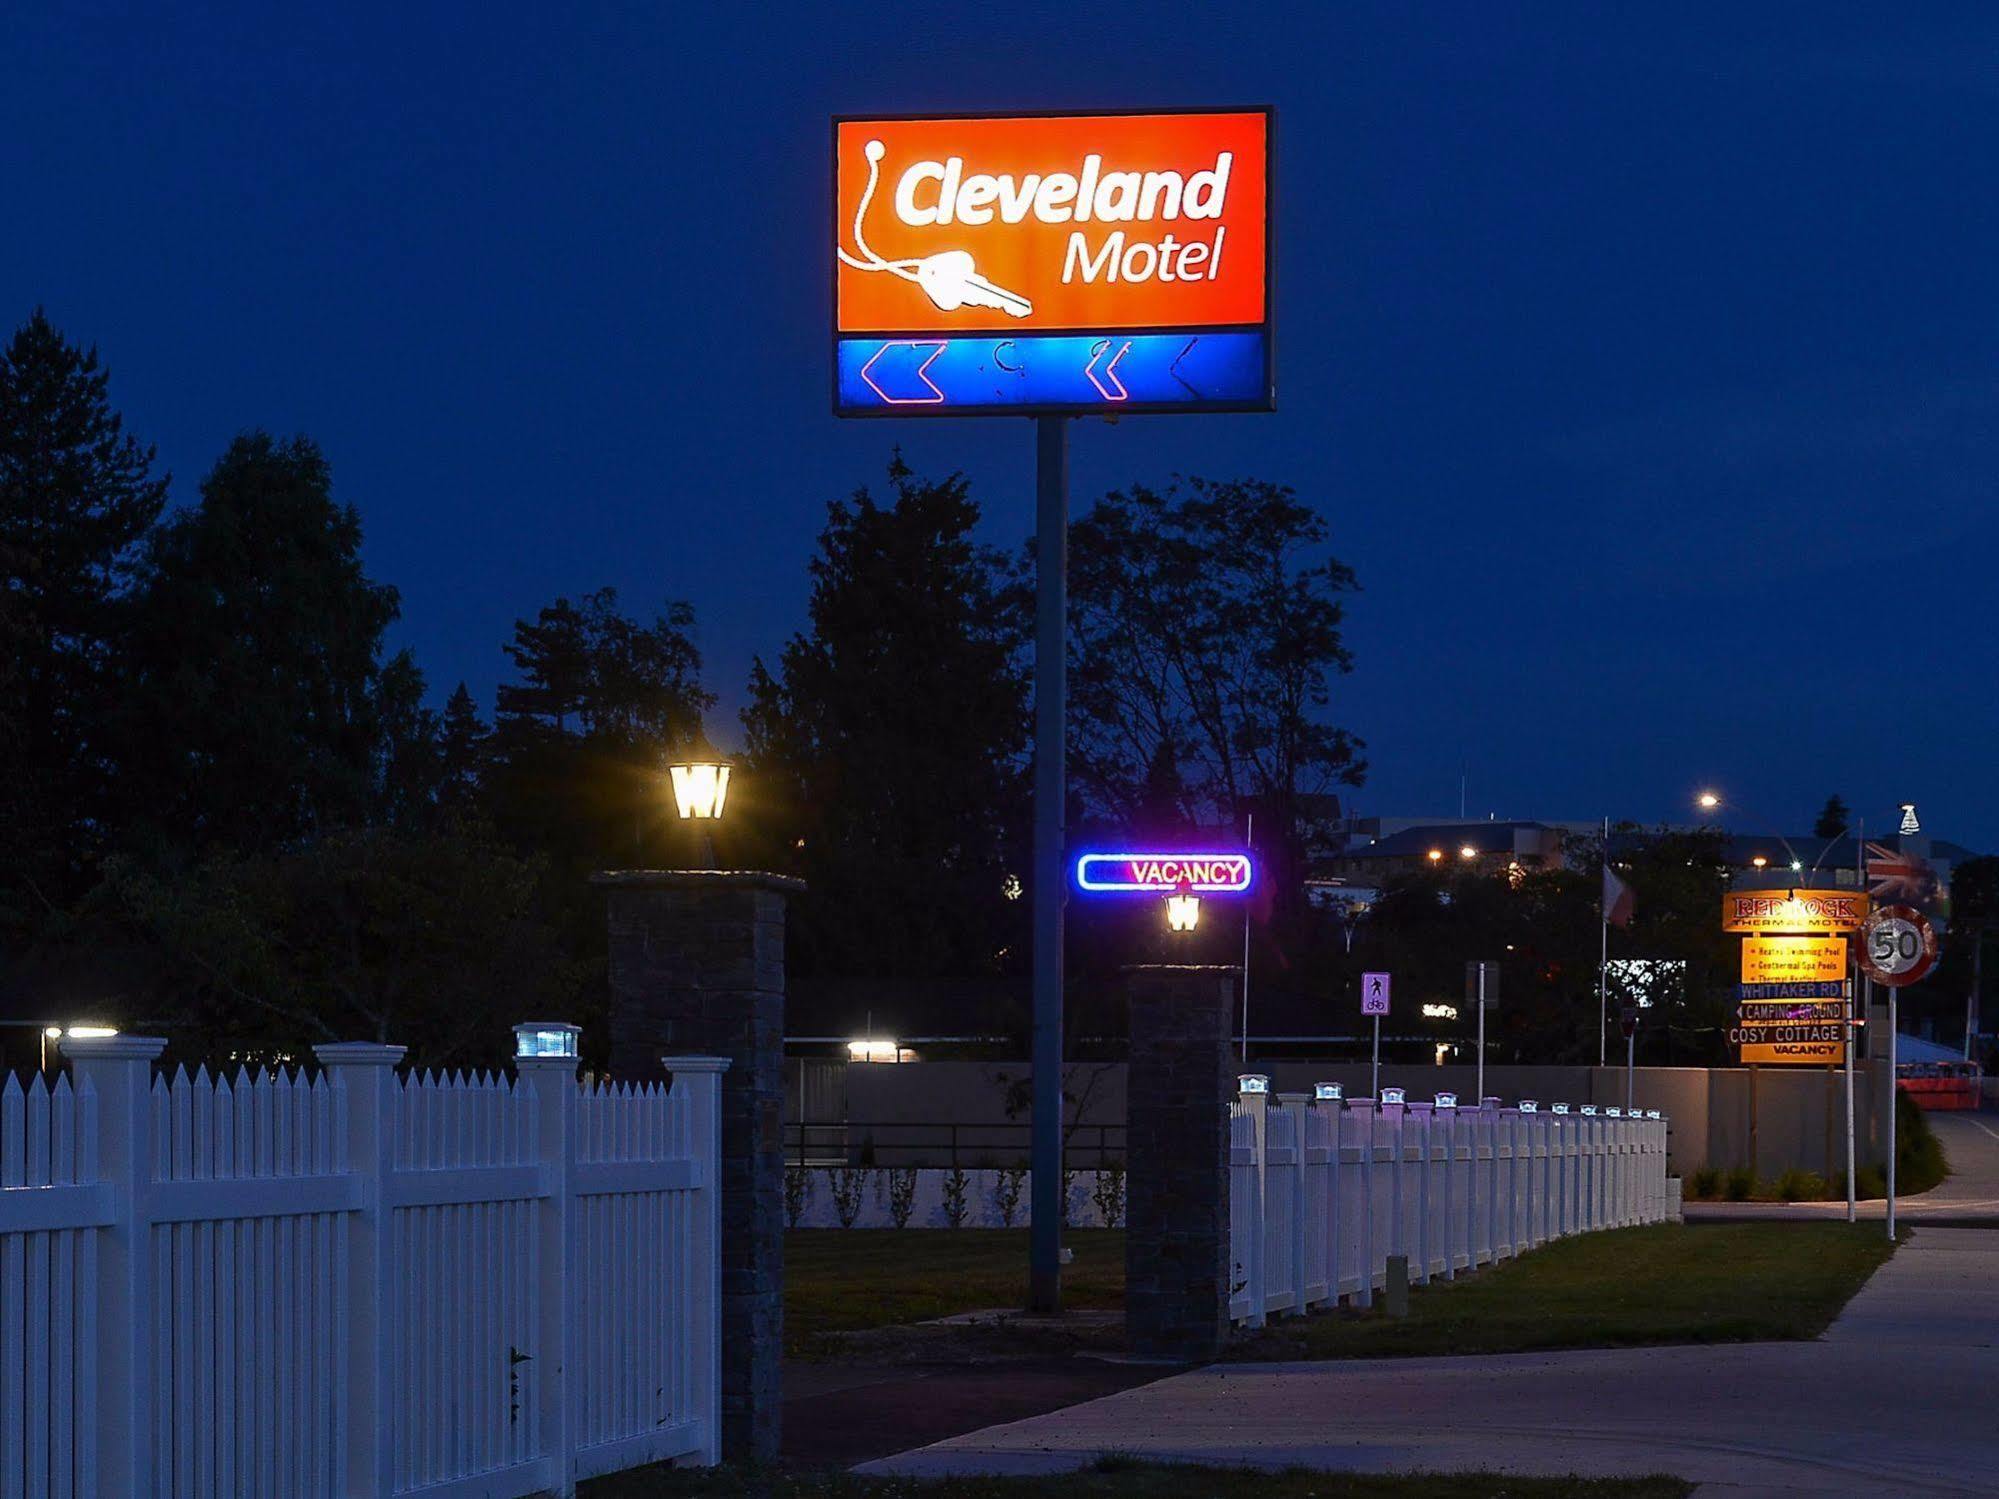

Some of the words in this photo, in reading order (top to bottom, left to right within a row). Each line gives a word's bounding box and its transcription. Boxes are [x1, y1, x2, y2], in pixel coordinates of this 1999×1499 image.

[895, 152, 1233, 226] Cleveland
[1061, 226, 1226, 284] Motel
[1132, 862, 1243, 883] VACANCY
[1734, 898, 1783, 918] RED
[1875, 930, 1918, 959] 50
[1741, 983, 1816, 999] WHITTAKER
[1819, 982, 1839, 996] RD
[1746, 1004, 1793, 1019] CAMPING
[1799, 1003, 1841, 1018] GROUND
[1730, 1028, 1767, 1043] COSY
[1775, 1026, 1840, 1041] COTTAGE
[1773, 1045, 1837, 1055] VACANCY
